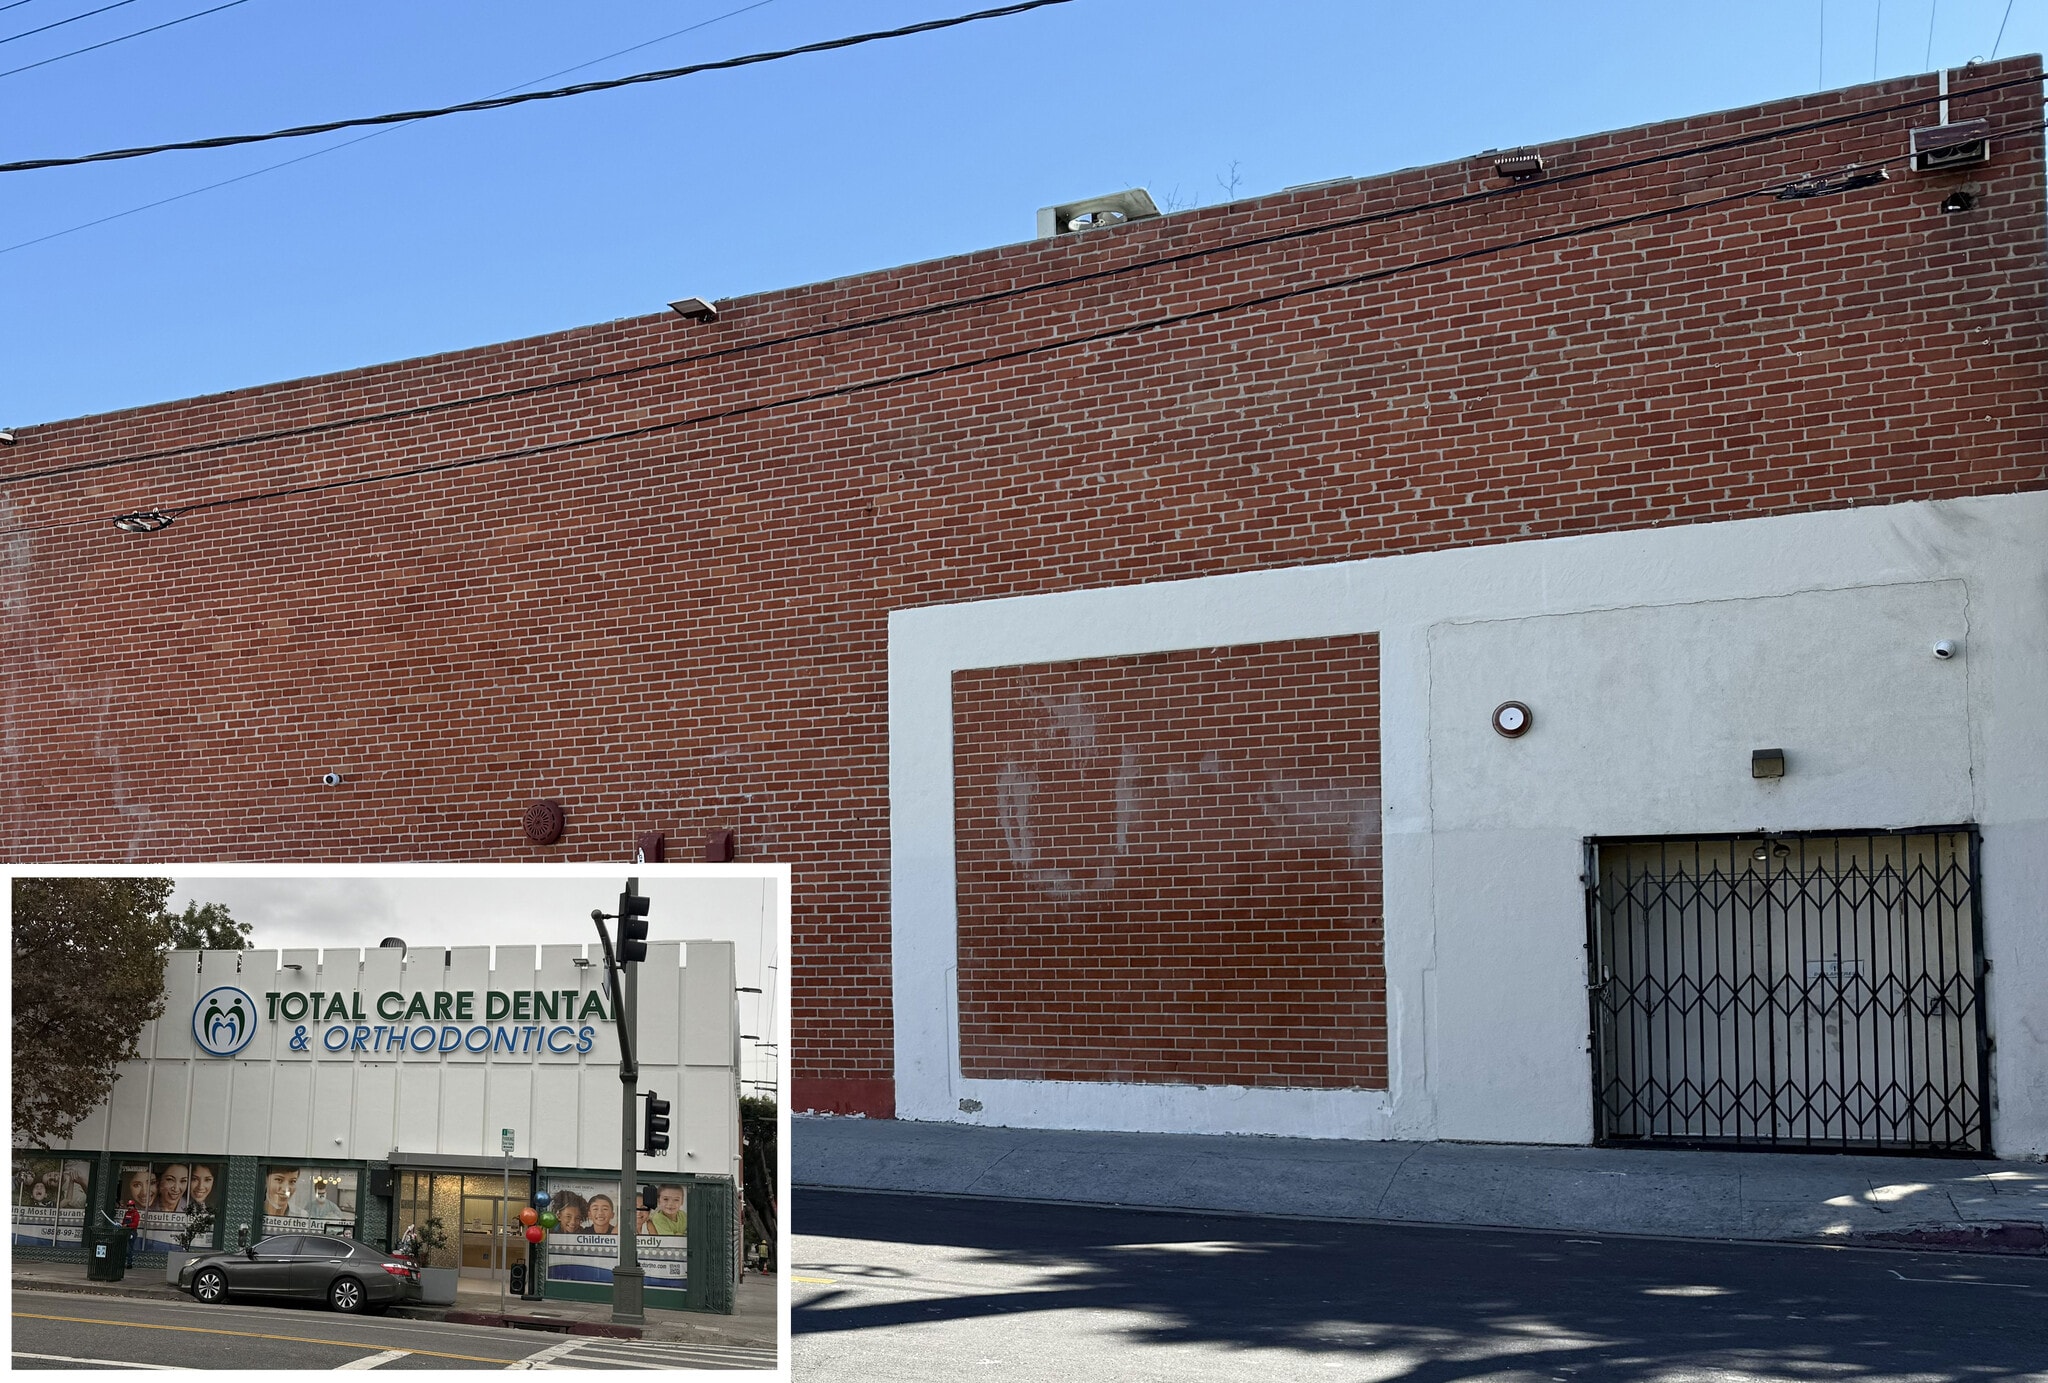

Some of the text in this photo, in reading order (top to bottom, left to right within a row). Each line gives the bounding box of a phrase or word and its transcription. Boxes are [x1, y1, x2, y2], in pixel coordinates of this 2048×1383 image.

[266, 992, 366, 1021] TOTAL
[377, 991, 474, 1021] CARE
[289, 1025, 595, 1053] & ORTHODONTICS
[28, 1207, 47, 1216] Most
[171, 1213, 185, 1222] For
[262, 1217, 281, 1226] State
[283, 1217, 291, 1226] of
[293, 1218, 306, 1228] the
[310, 1220, 323, 1229] Art
[577, 1235, 616, 1245] Children
